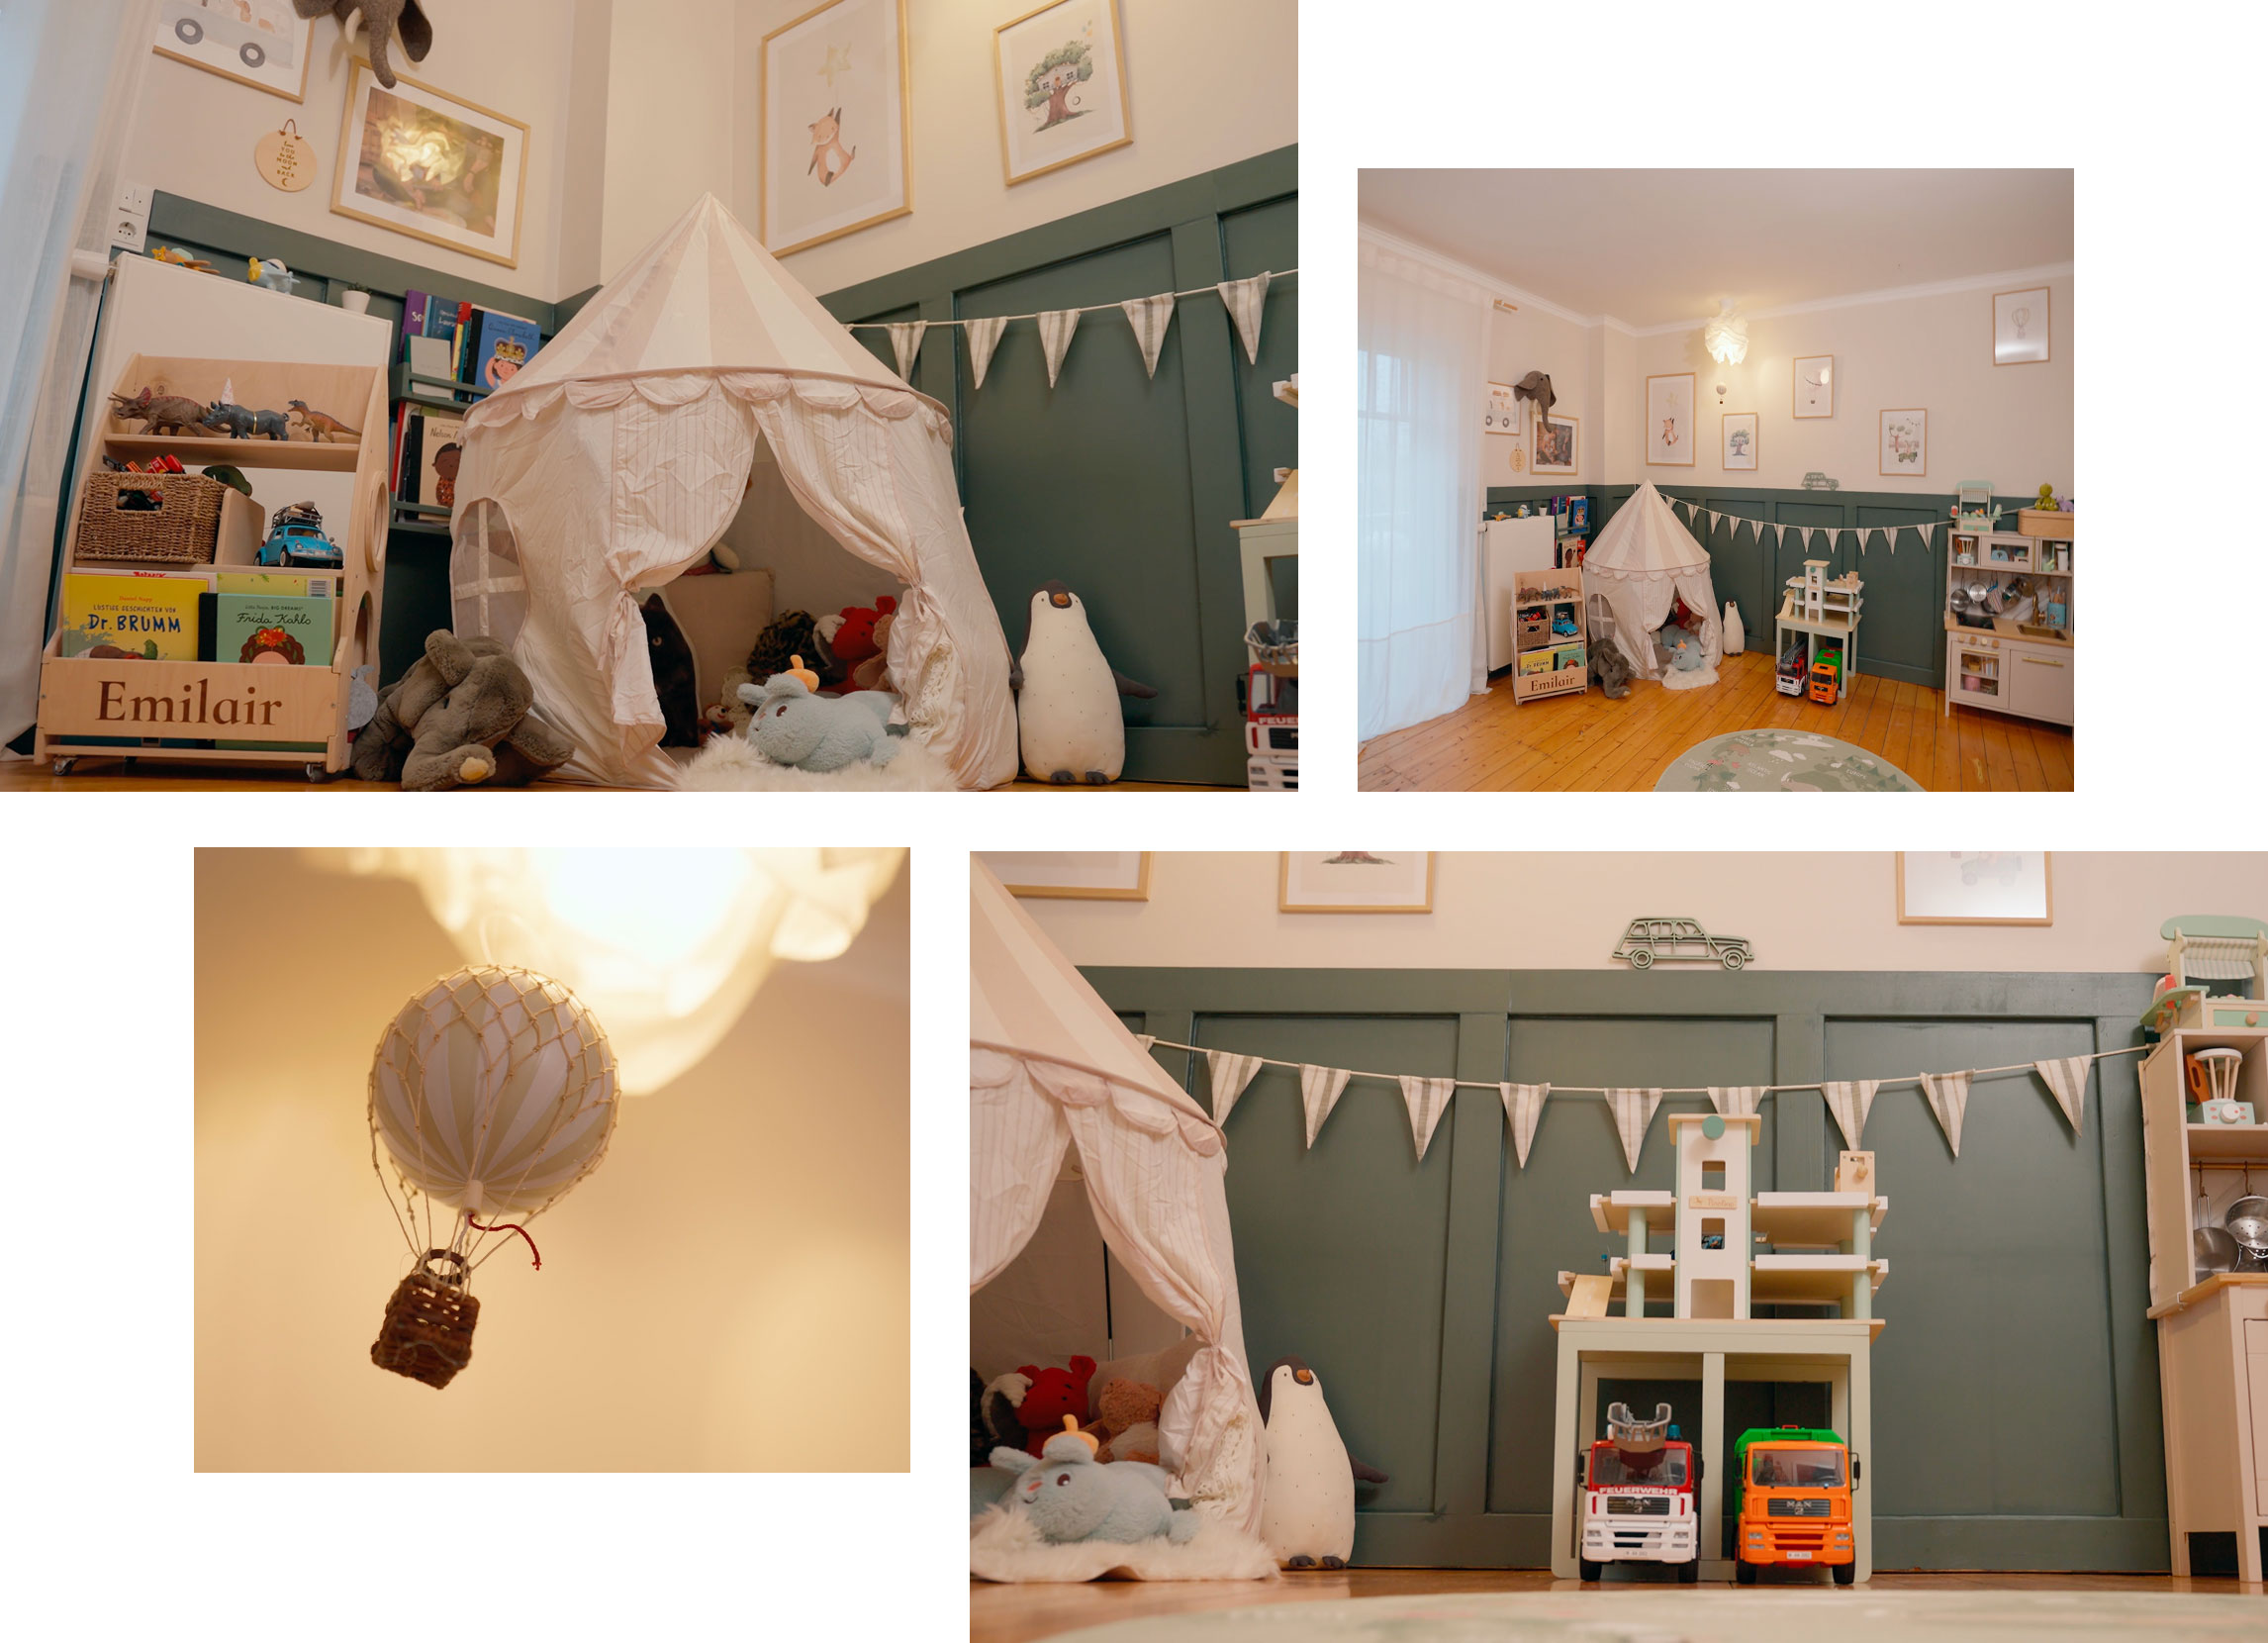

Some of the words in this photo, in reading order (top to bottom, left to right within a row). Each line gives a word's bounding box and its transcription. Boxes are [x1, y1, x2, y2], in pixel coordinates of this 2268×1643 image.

[276, 156, 298, 166] MOON
[276, 169, 295, 178] BACK
[429, 427, 452, 438] Nelson
[87, 614, 113, 630] Dr.
[117, 615, 181, 633] BRUMM
[236, 612, 272, 625] Frida
[275, 613, 312, 626] Kahlo
[1531, 675, 1575, 692] Emilair
[95, 678, 283, 726] Emilair
[1599, 1487, 1678, 1496] FEUERWEHR
